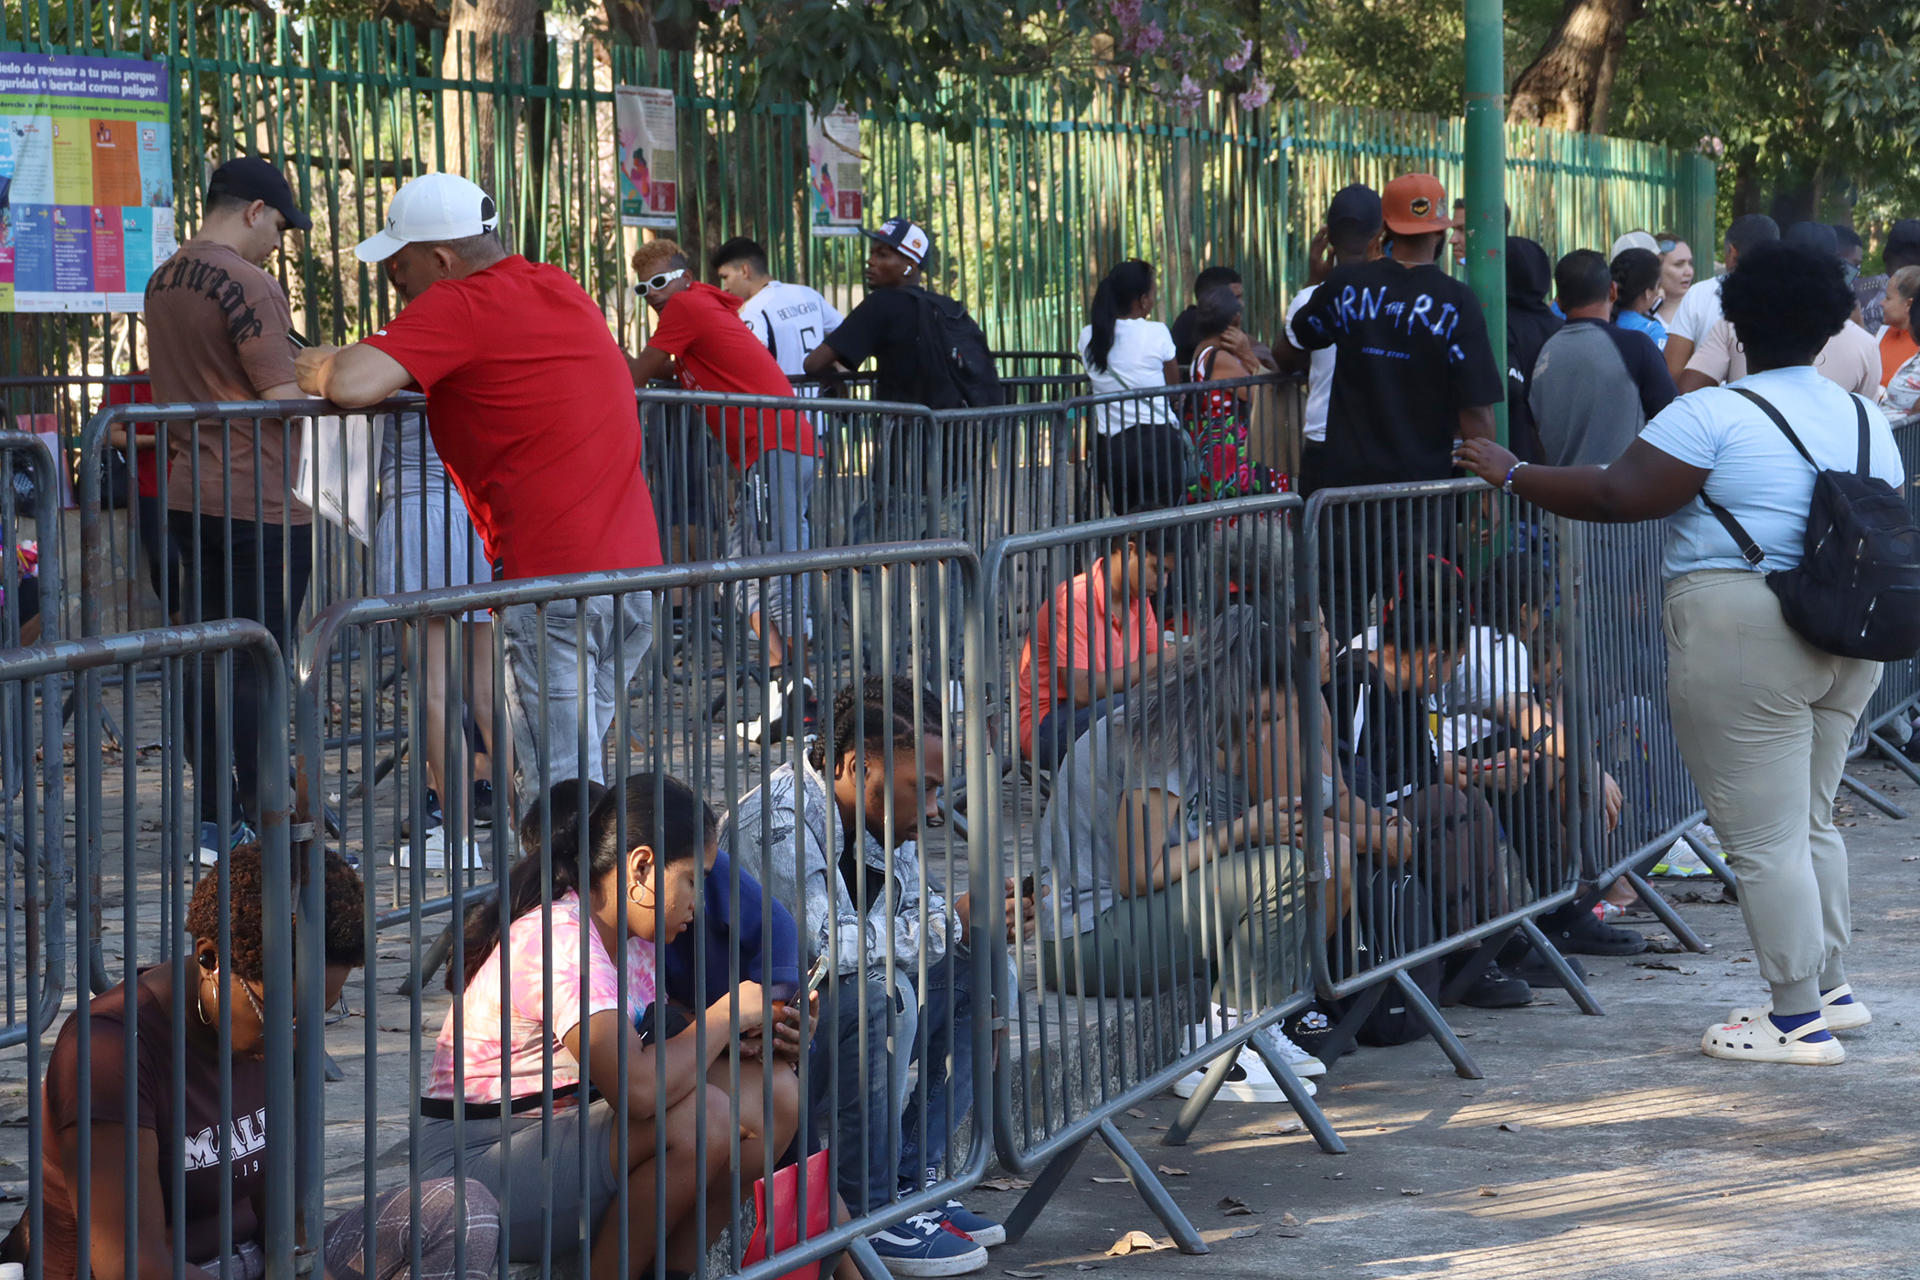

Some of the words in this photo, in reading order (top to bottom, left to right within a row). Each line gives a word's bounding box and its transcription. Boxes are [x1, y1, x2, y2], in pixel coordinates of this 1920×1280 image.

[23, 63, 36, 75] de
[79, 68, 86, 77] a
[88, 67, 99, 78] tu
[123, 71, 156, 84] porque
[88, 83, 120, 94] corren
